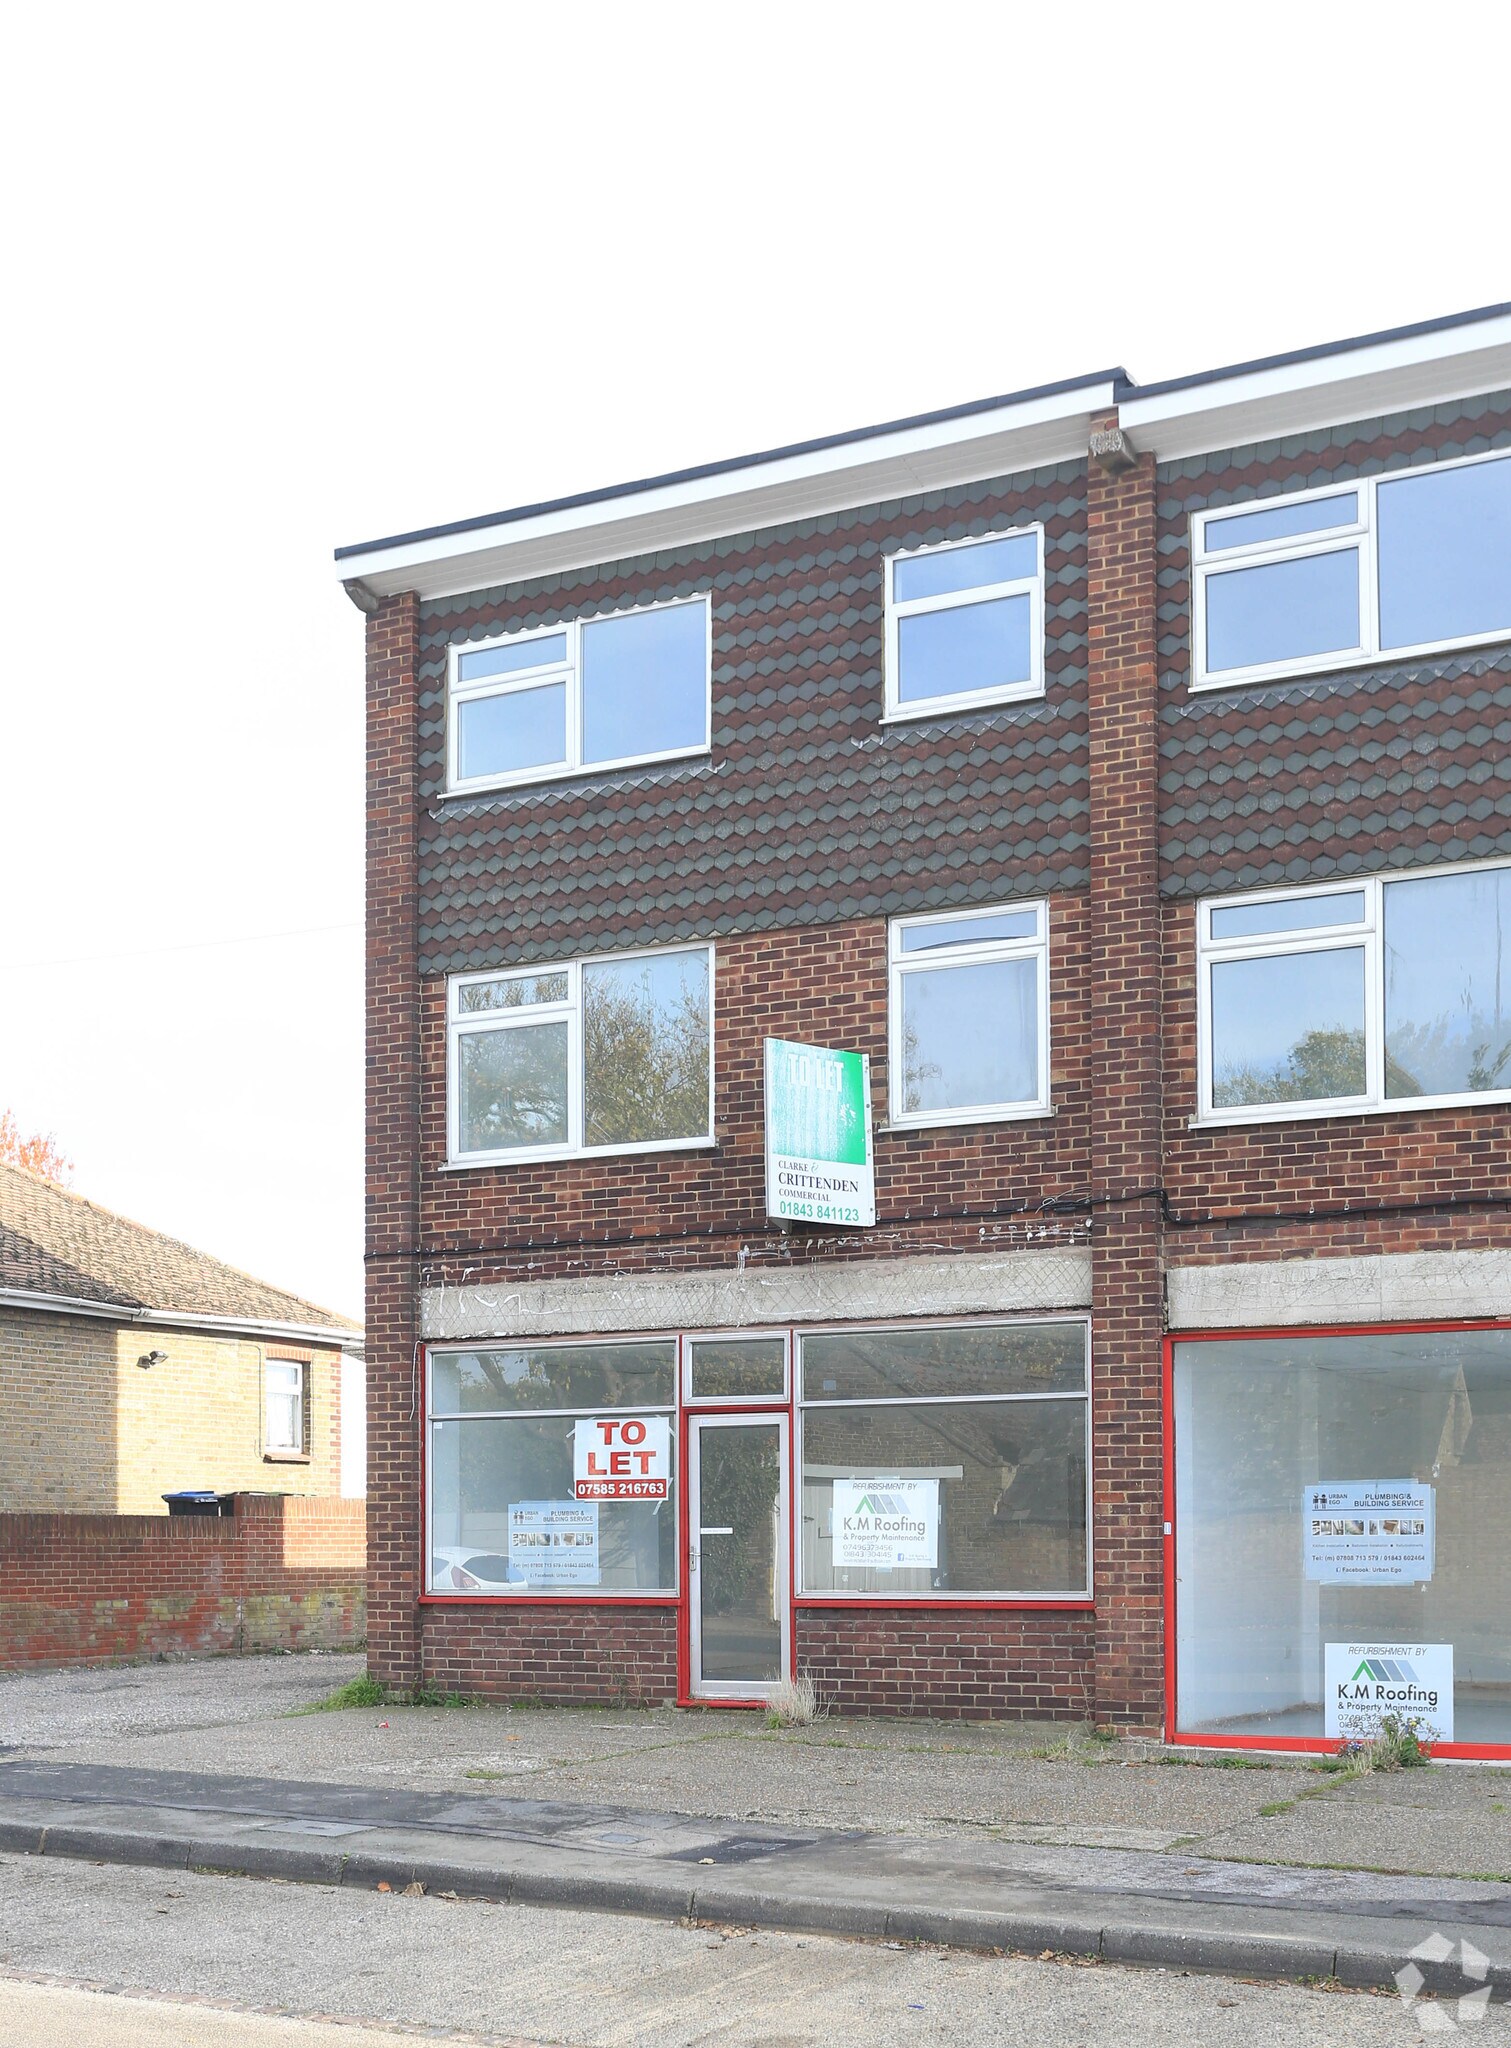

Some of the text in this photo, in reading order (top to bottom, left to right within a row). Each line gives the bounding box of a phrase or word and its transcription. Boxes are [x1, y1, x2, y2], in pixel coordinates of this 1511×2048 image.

[787, 1052, 845, 1093] TO LET
[778, 1160, 809, 1172] CLARKE
[778, 1172, 859, 1192] CRITTENDEN
[779, 1188, 831, 1202] COMMERCIAL
[780, 1200, 859, 1221] 01843 841123
[597, 1420, 647, 1445] TO
[588, 1451, 657, 1475] LET
[577, 1483, 664, 1495] 07585 216763
[852, 1482, 918, 1491] REFURBISHMENT BY
[843, 1515, 926, 1535] K.M Roofing
[850, 1533, 880, 1543] Property
[881, 1534, 925, 1542] Maintenance
[1348, 1646, 1428, 1656] REFURBISHMENT BY
[1337, 1684, 1438, 1706] K.M Roofing
[1337, 1701, 1438, 1713] & Property Maintenance
